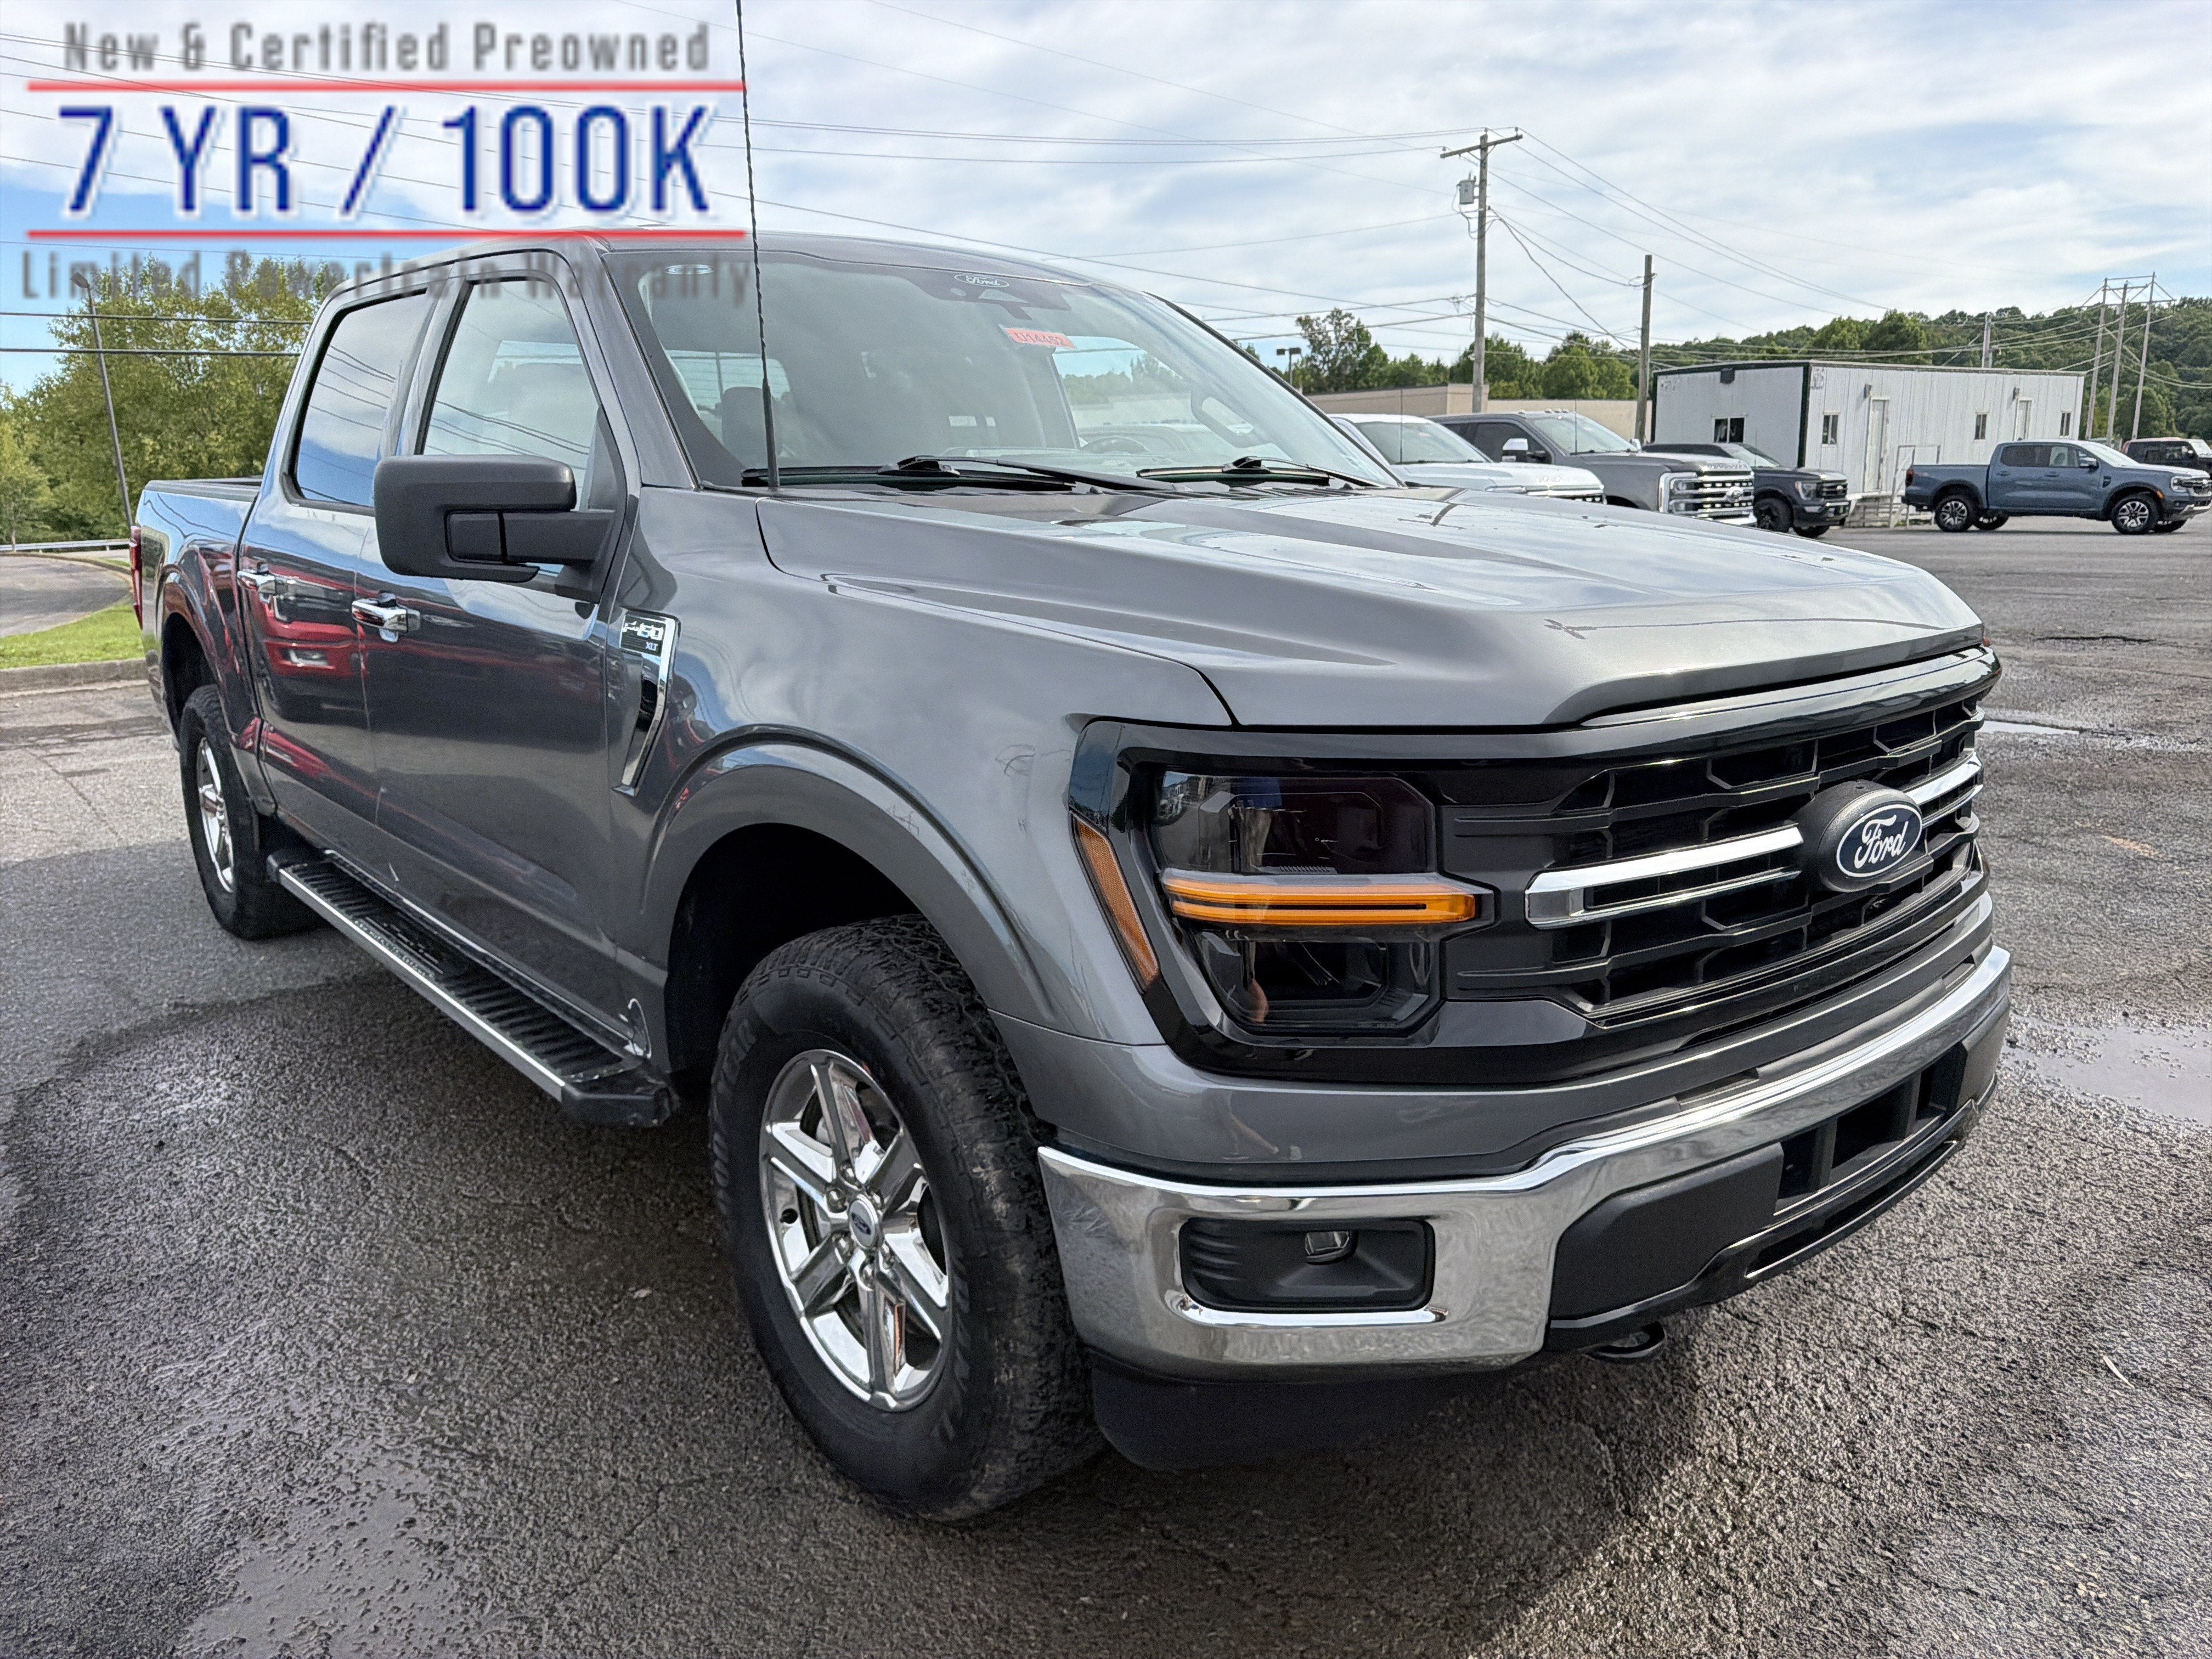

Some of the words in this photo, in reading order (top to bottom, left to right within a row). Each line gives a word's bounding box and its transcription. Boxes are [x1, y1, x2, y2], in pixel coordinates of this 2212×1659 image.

[965, 275, 1001, 286] Ford
[645, 641, 658, 651] XLT
[1854, 814, 1909, 869] Ford
